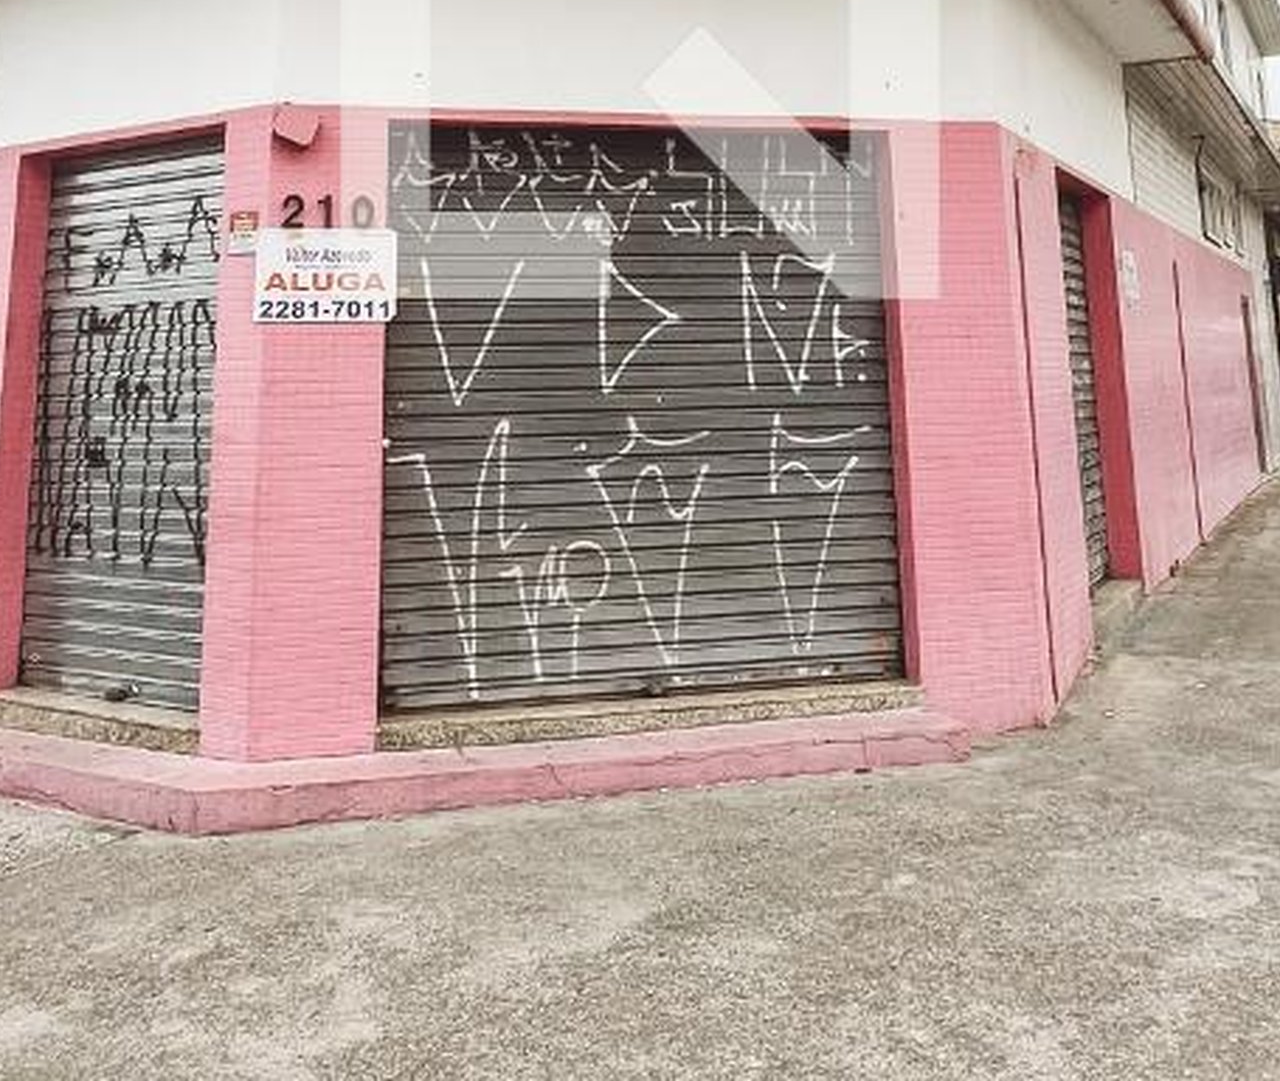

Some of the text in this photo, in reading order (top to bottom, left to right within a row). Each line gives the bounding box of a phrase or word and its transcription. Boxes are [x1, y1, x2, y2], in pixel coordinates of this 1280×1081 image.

[280, 194, 375, 229] 210
[264, 273, 386, 291] ALUGA
[258, 300, 390, 319] 2281-7011
